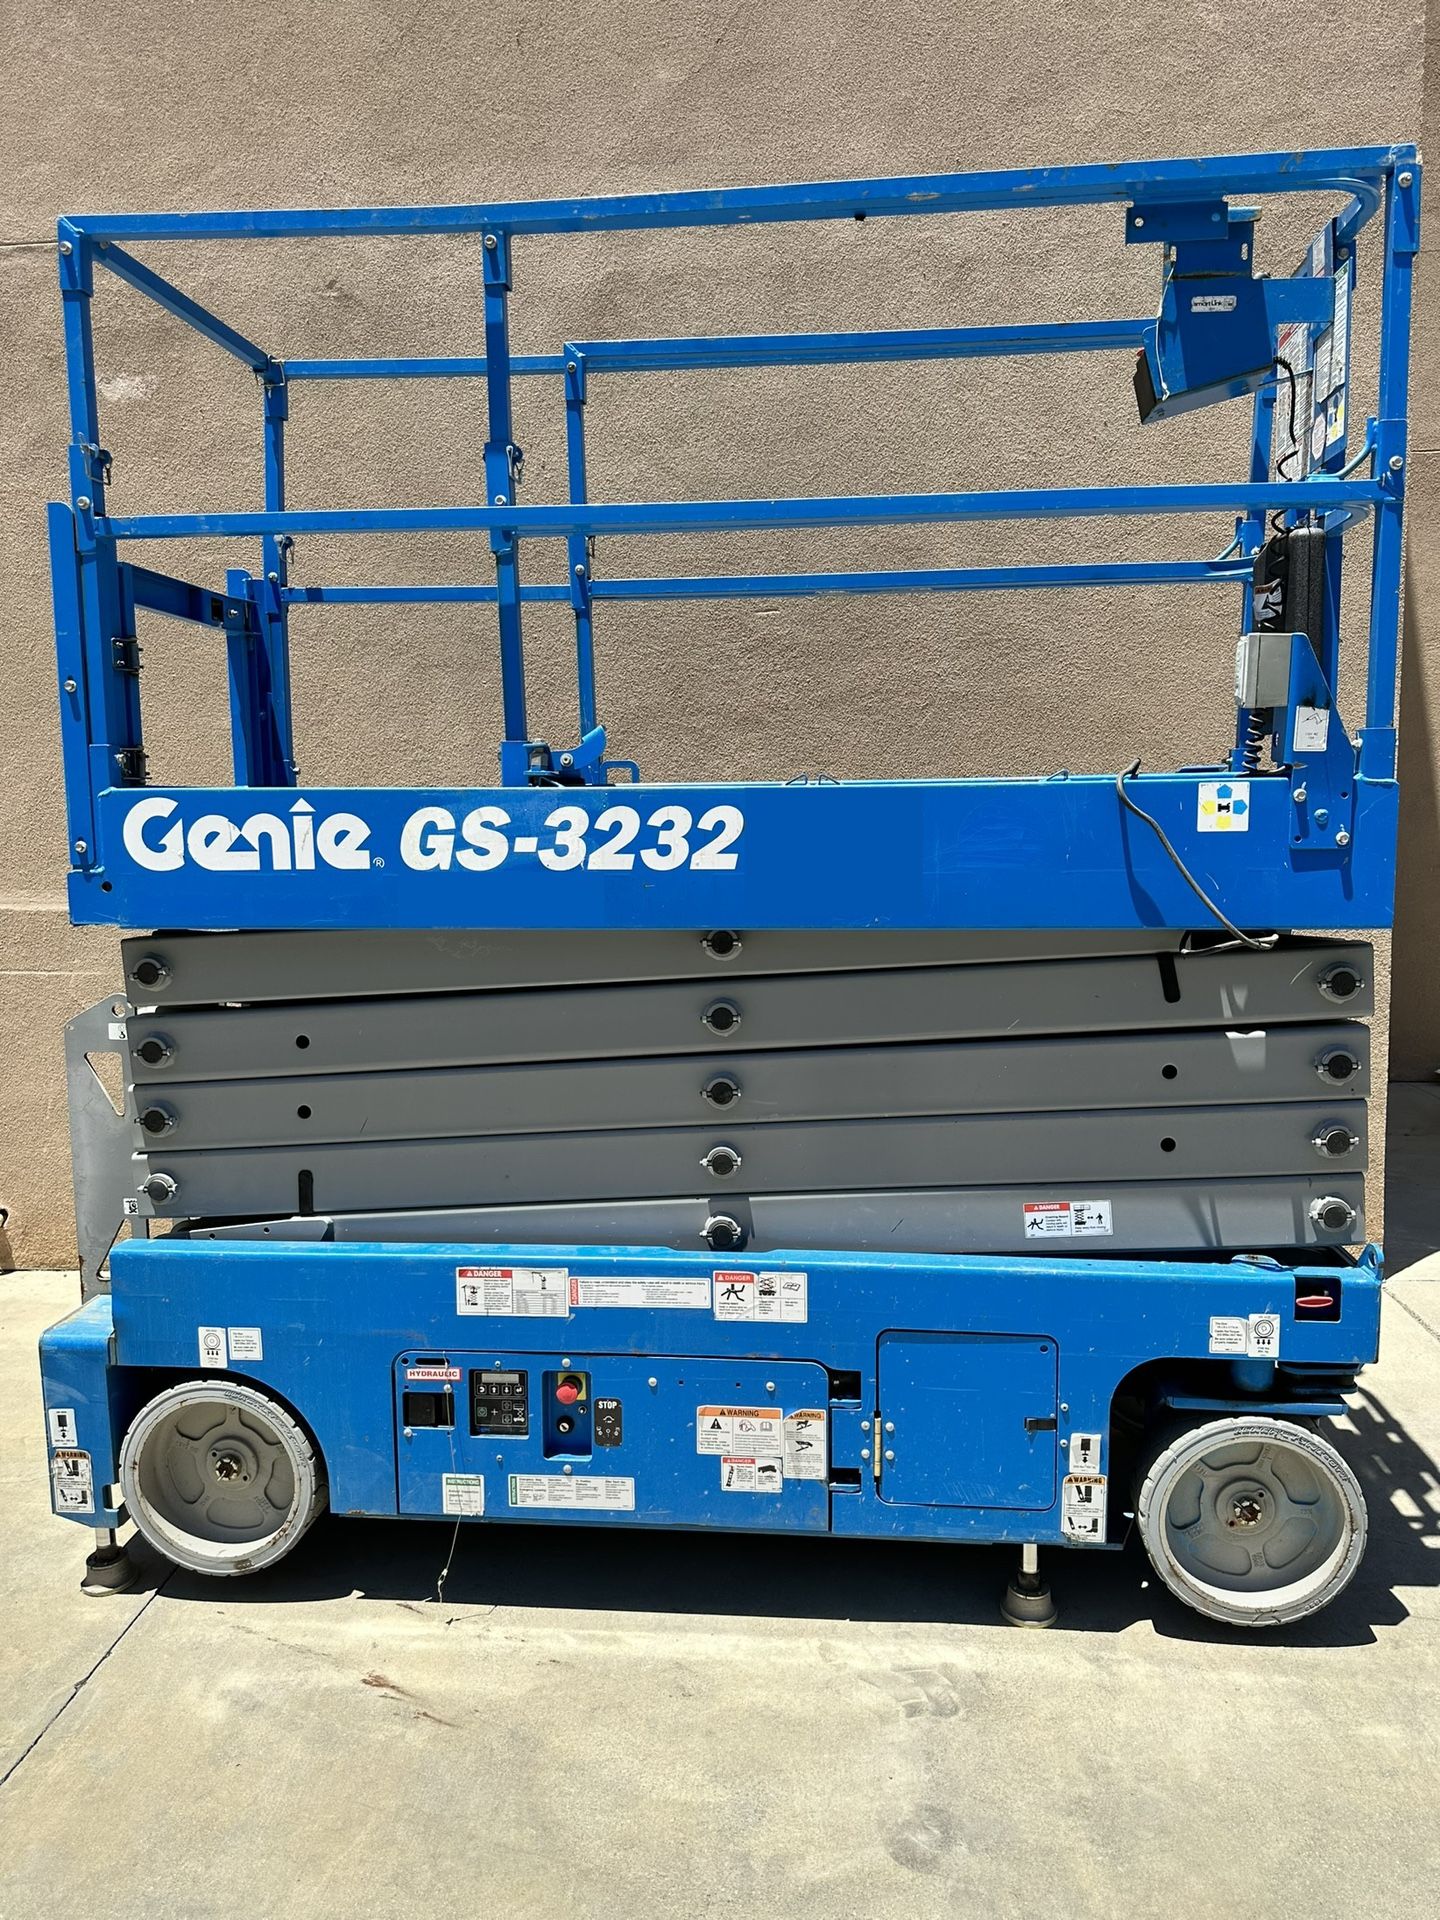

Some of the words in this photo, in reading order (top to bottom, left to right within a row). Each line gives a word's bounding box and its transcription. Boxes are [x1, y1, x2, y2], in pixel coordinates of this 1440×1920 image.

[123, 797, 371, 871] Genie
[400, 804, 745, 872] GS-3232
[598, 1400, 617, 1408] STOP
[727, 1409, 760, 1417] WARNING
[1073, 1476, 1103, 1484] WARNING
